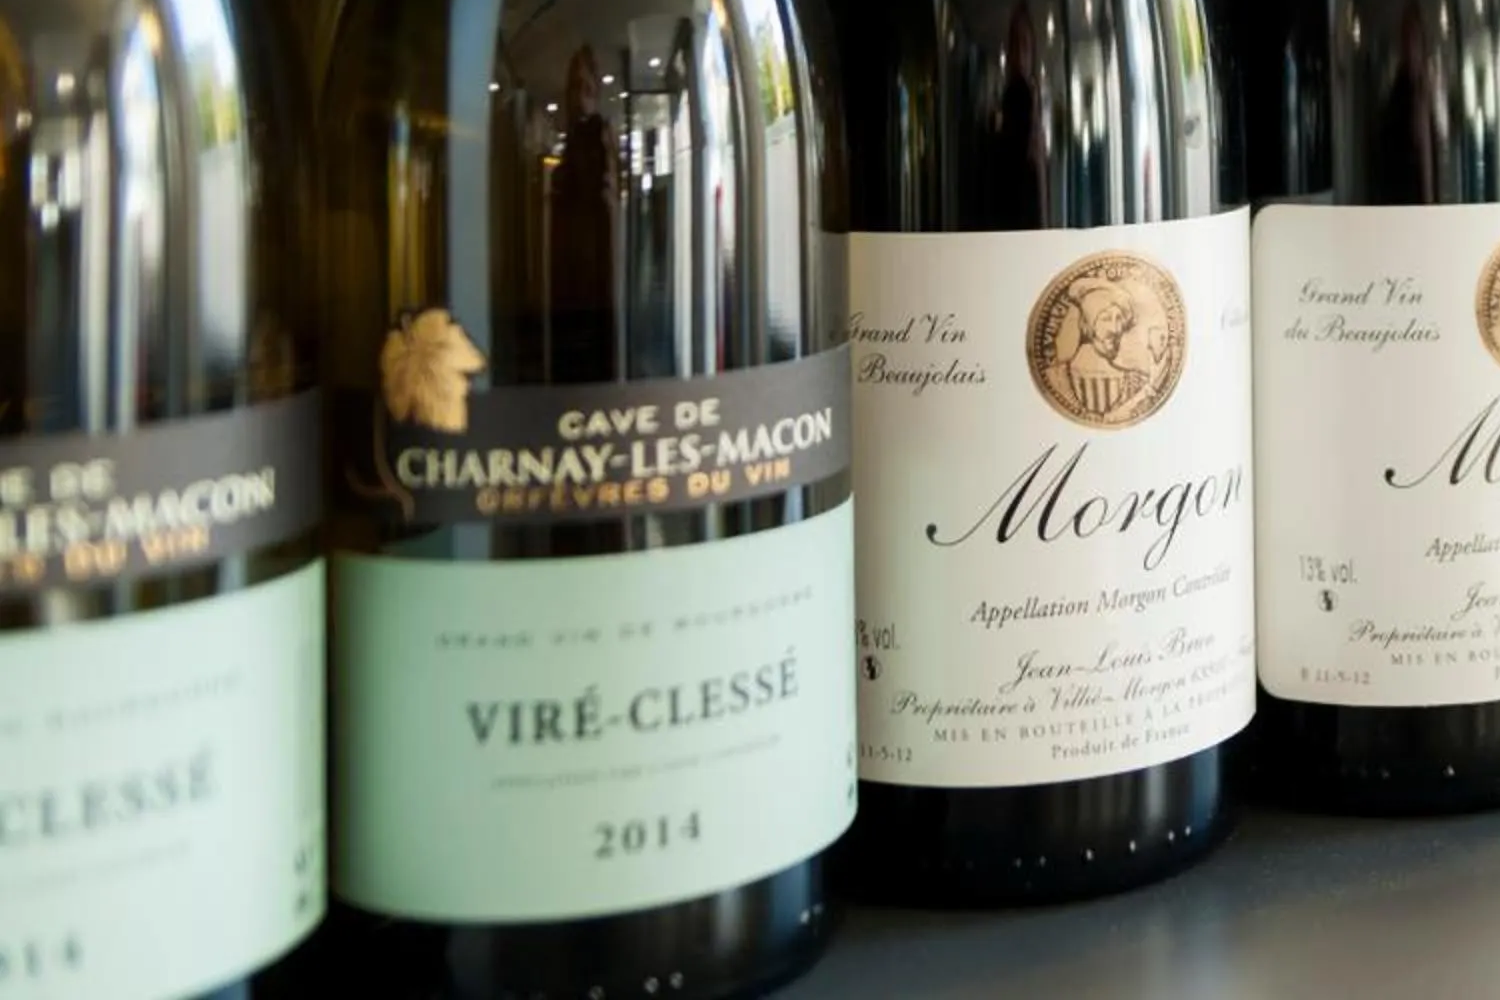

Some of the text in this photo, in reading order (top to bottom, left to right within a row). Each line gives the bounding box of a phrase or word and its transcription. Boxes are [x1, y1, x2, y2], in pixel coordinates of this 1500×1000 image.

[1298, 276, 1423, 306] Grand Vin
[919, 312, 967, 345] Vin
[1284, 314, 1441, 353] du Beaujolais
[857, 352, 987, 398] Beaujolais
[557, 397, 722, 441] CAVE DE
[397, 406, 834, 490] CHARNAY-LES-MACON
[686, 469, 732, 498] DU
[744, 458, 791, 487] VIN
[926, 441, 1243, 571] Morgon
[969, 597, 1090, 630] Appellation
[464, 645, 803, 748] VIRÉ-CLESSÉ
[889, 688, 1019, 725] Propriétaire
[933, 727, 970, 743] MIS
[981, 726, 1008, 743] EN
[1050, 738, 1118, 761] Produit
[1120, 734, 1140, 751] de
[593, 810, 704, 861] 2014
